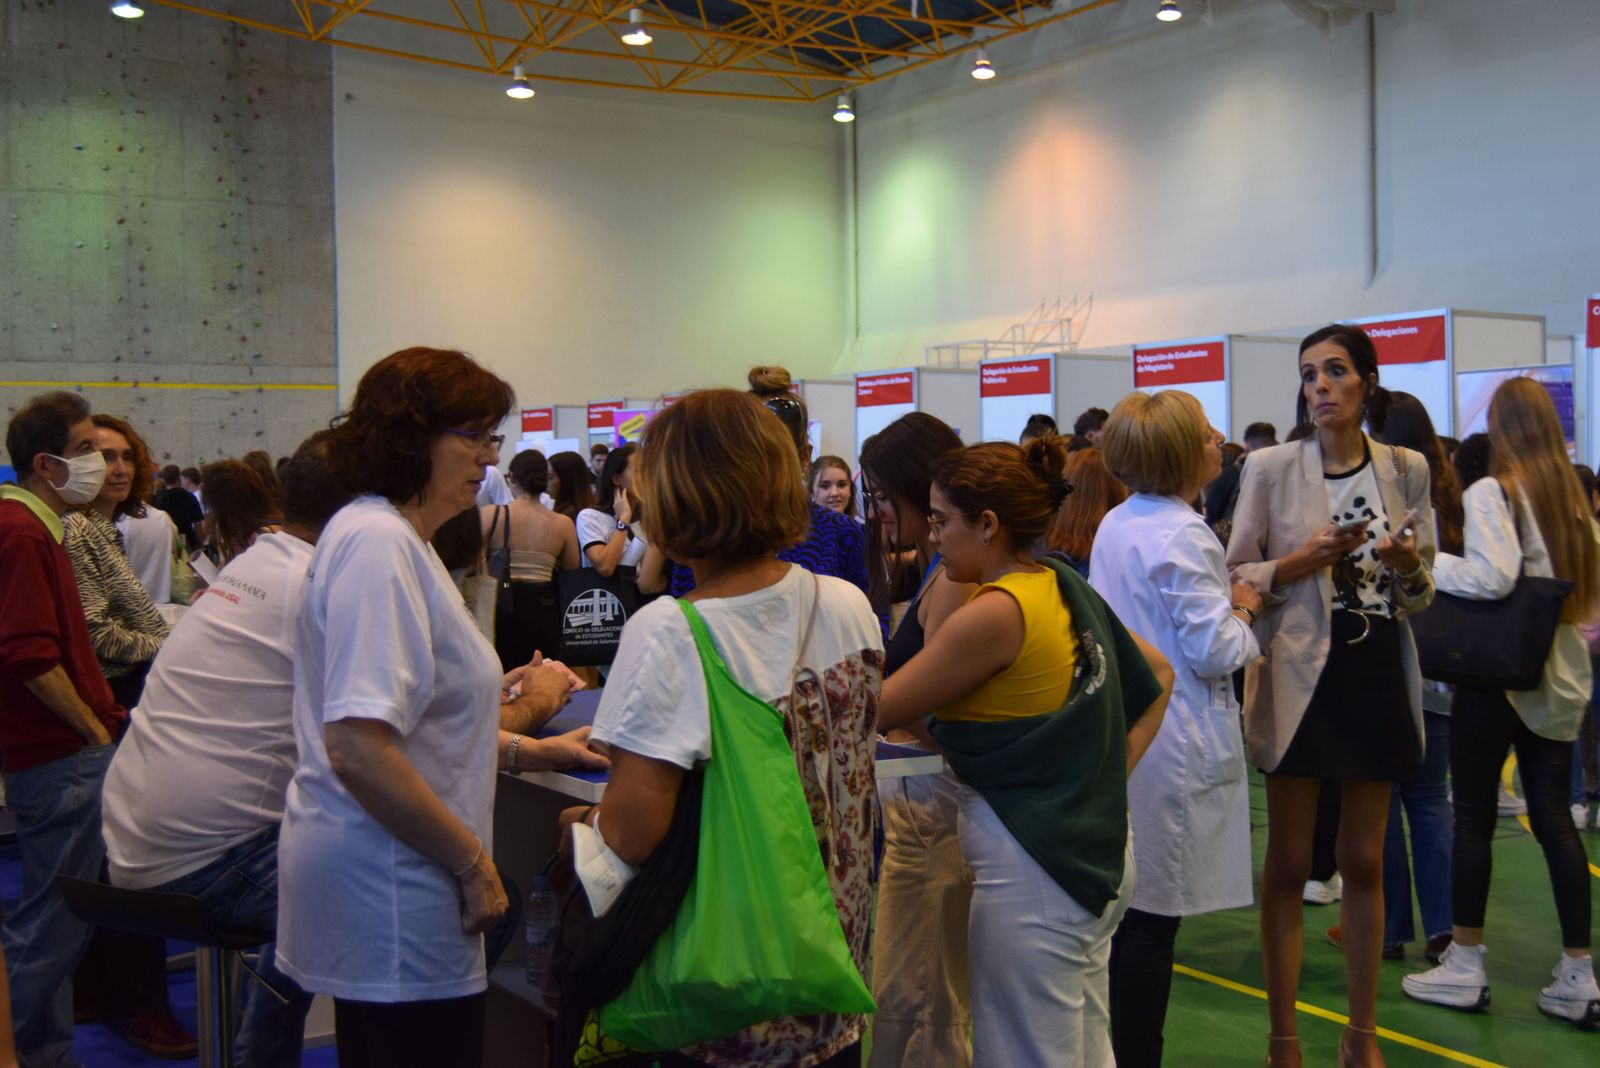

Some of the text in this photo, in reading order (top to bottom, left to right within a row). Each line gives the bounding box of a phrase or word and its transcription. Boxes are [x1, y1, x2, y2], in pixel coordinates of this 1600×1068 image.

[1372, 327, 1418, 337] Delegaciones
[1136, 350, 1208, 363] Delegación de Estudiantes
[982, 366, 1006, 376] Delegación
[1012, 364, 1039, 374] Estudiantes
[1136, 362, 1175, 373] de Magisterio
[591, 625, 624, 633] DELEGACION
